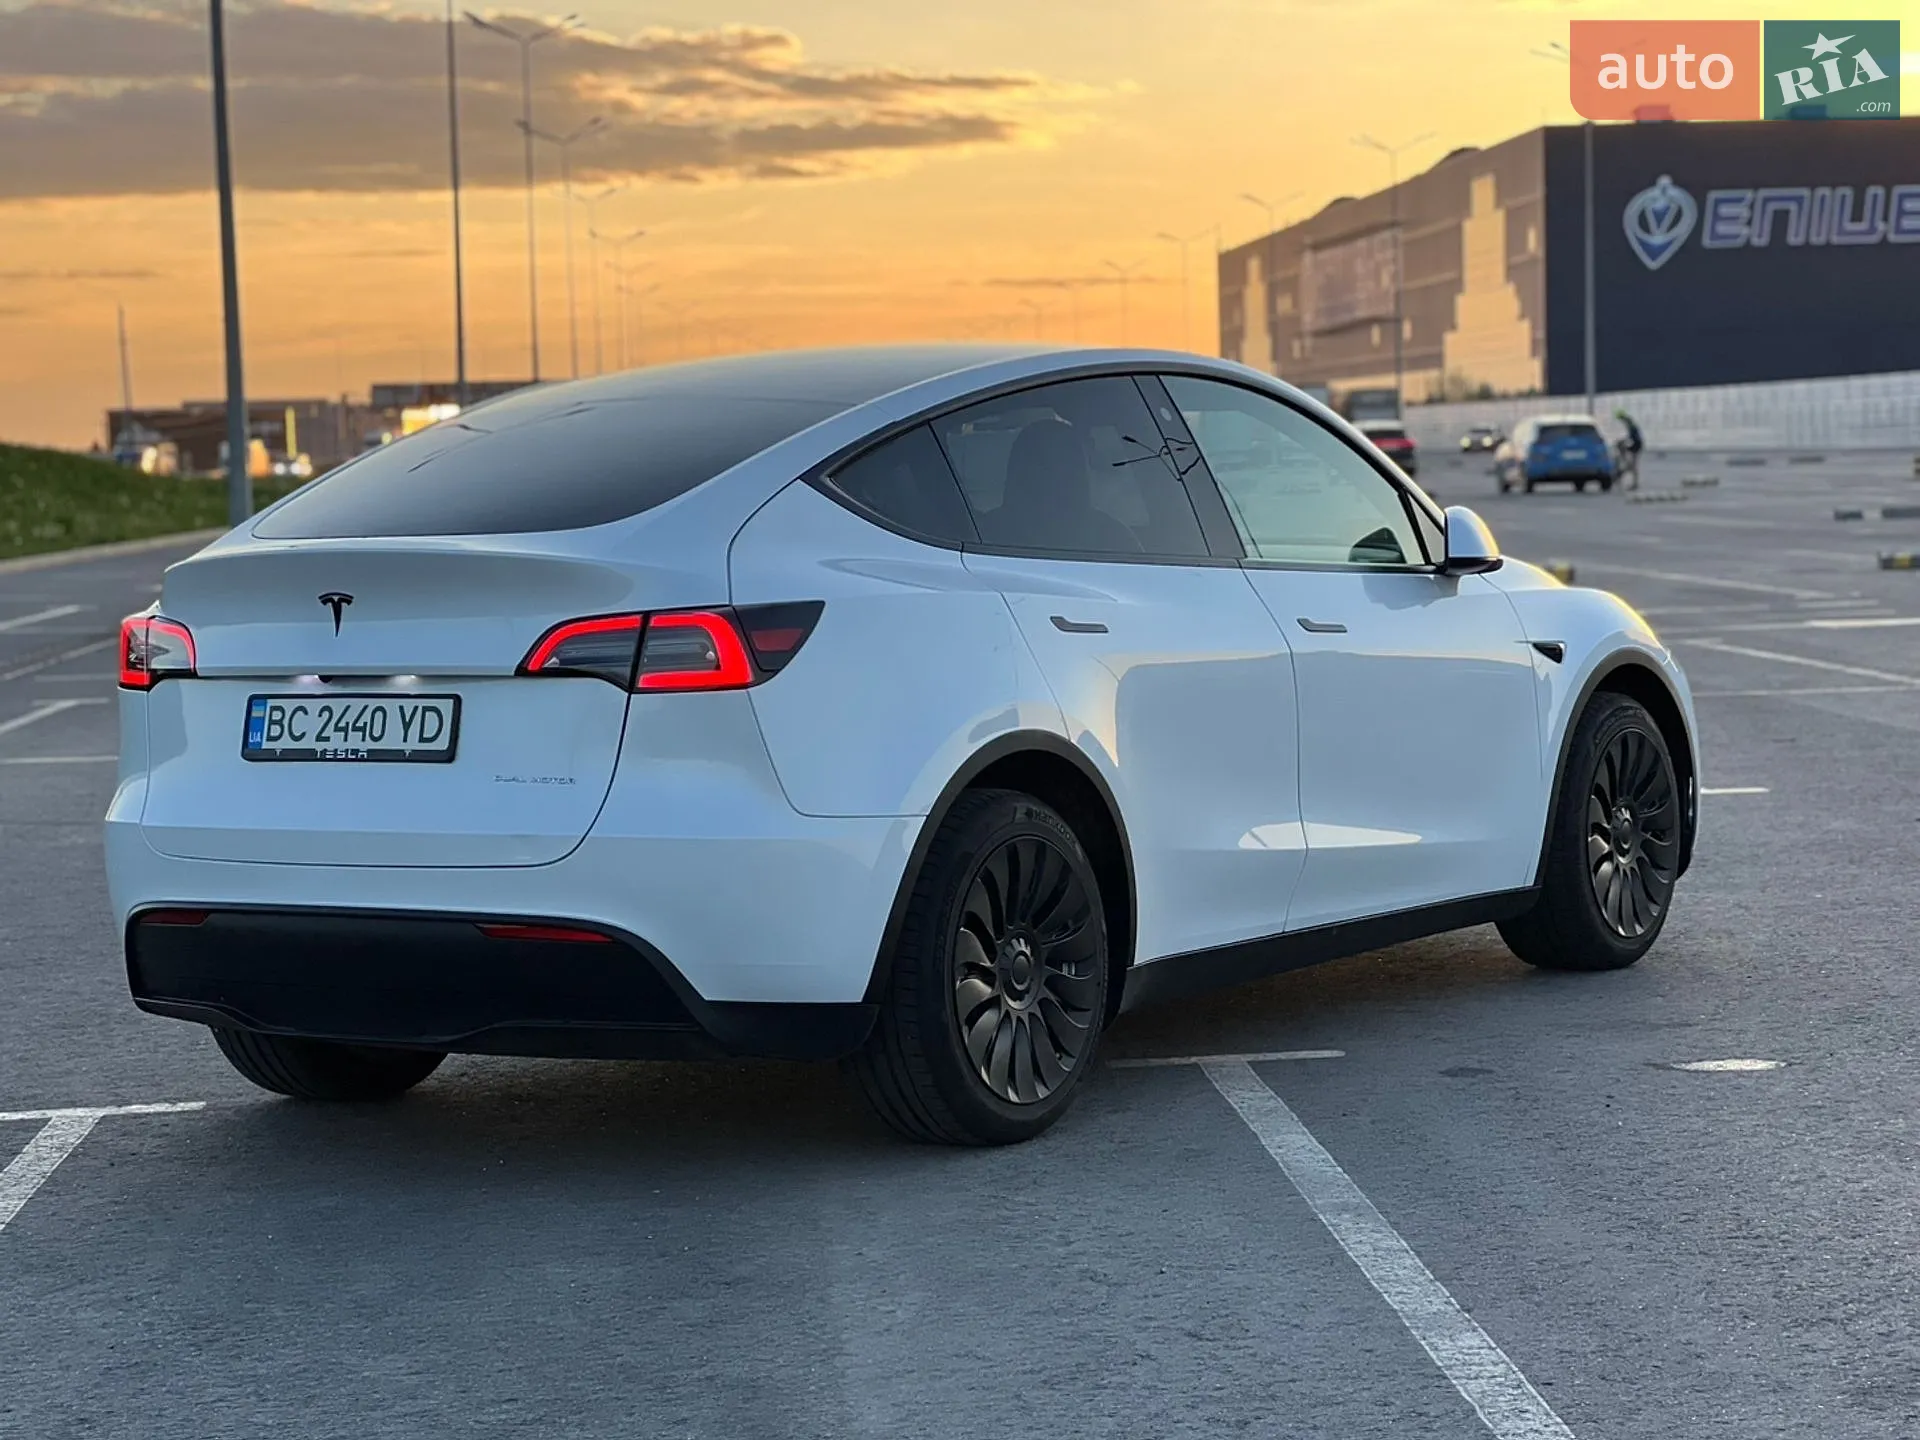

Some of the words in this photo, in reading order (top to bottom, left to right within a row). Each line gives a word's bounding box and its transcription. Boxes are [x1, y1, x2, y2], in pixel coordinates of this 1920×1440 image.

[266, 705, 309, 742] BC
[315, 705, 387, 743] 2440
[398, 705, 444, 743] YD
[249, 731, 262, 743] UA
[316, 749, 367, 759] TESLA
